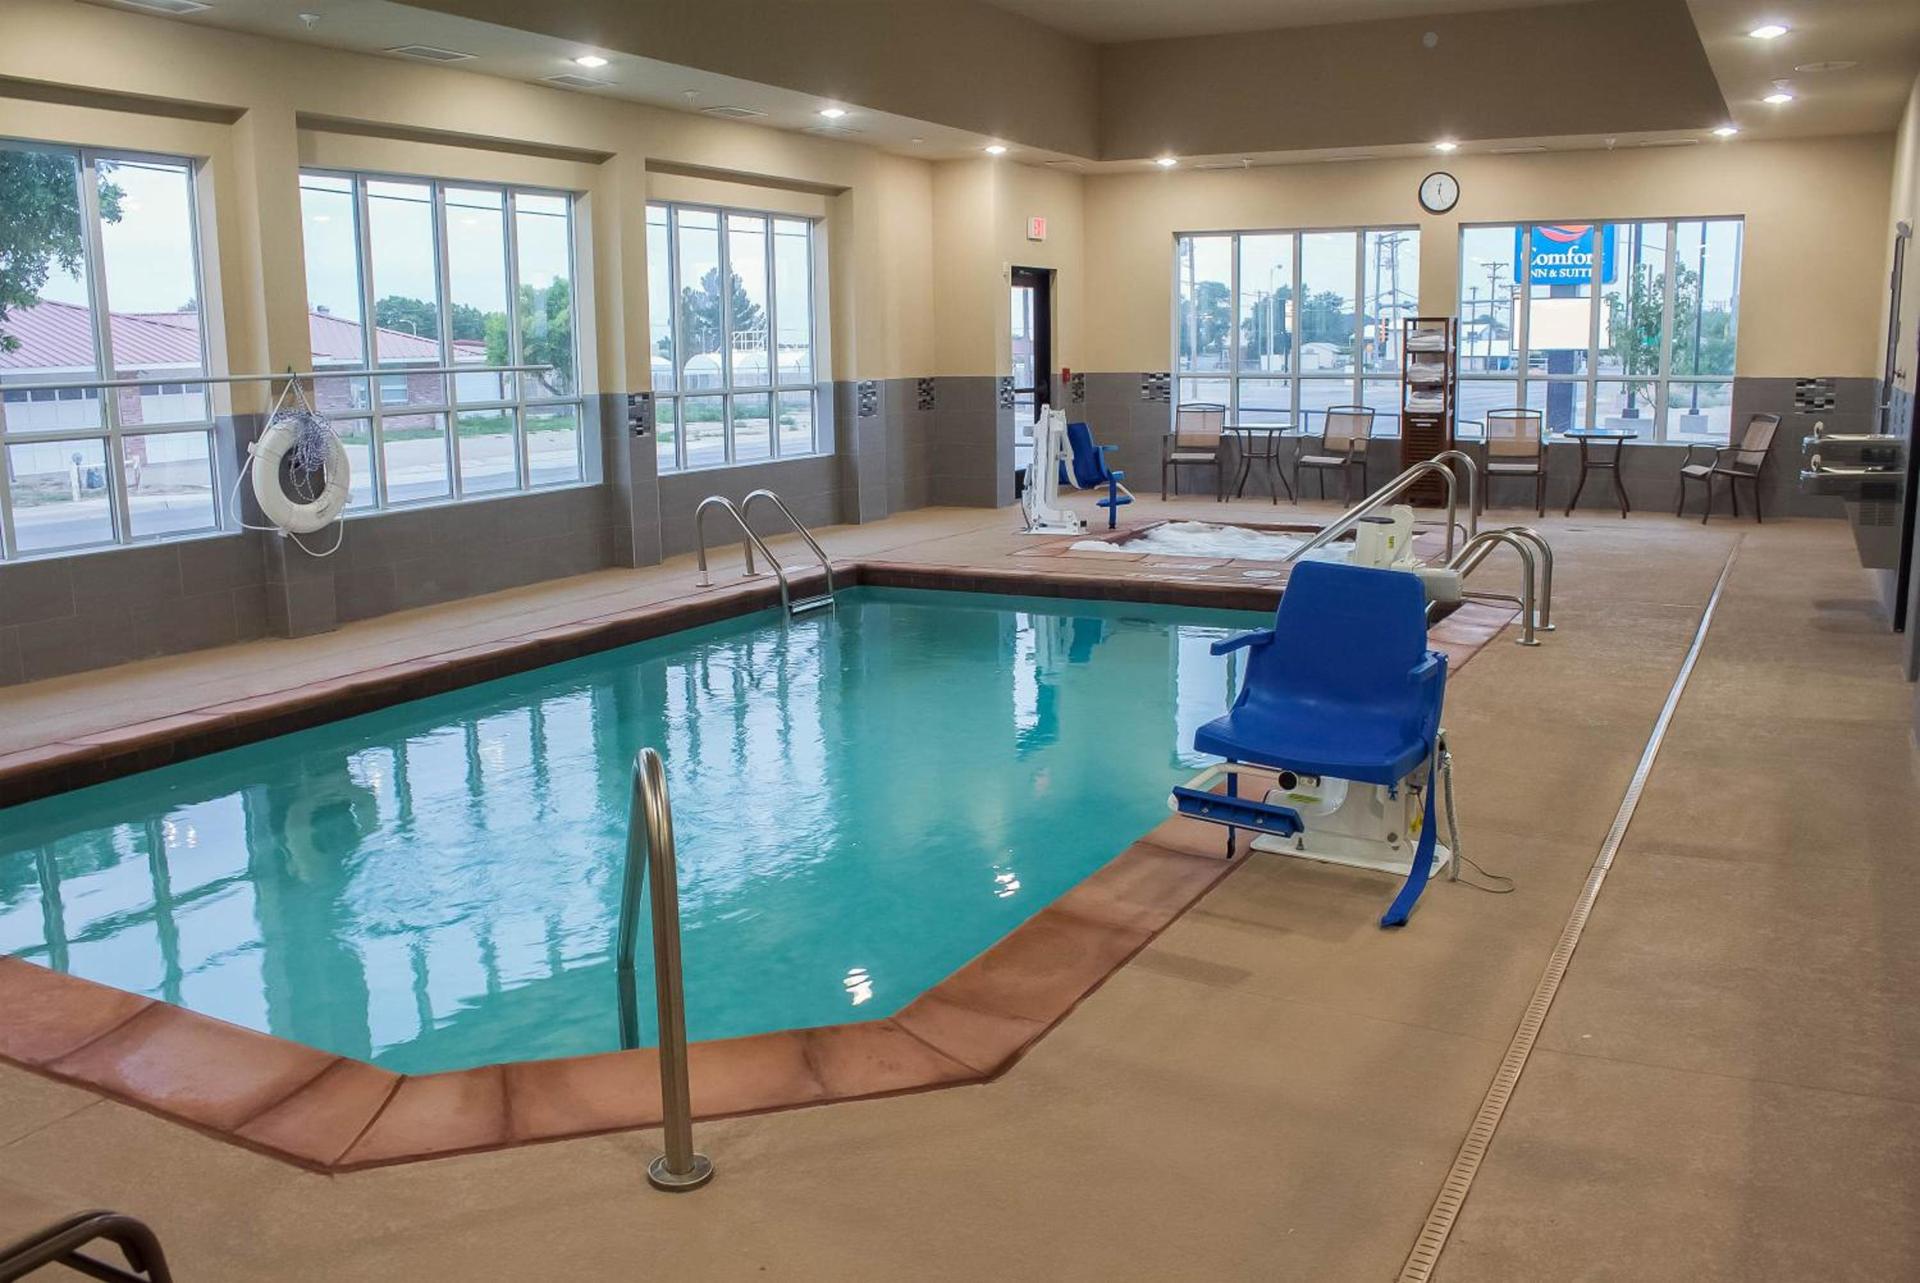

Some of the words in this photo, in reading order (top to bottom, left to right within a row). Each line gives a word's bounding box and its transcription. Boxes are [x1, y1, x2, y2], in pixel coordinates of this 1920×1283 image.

[1521, 245, 1605, 266] omfor
[1530, 268, 1547, 278] NN
[1549, 268, 1558, 278] &
[1559, 268, 1593, 278] SUIT
